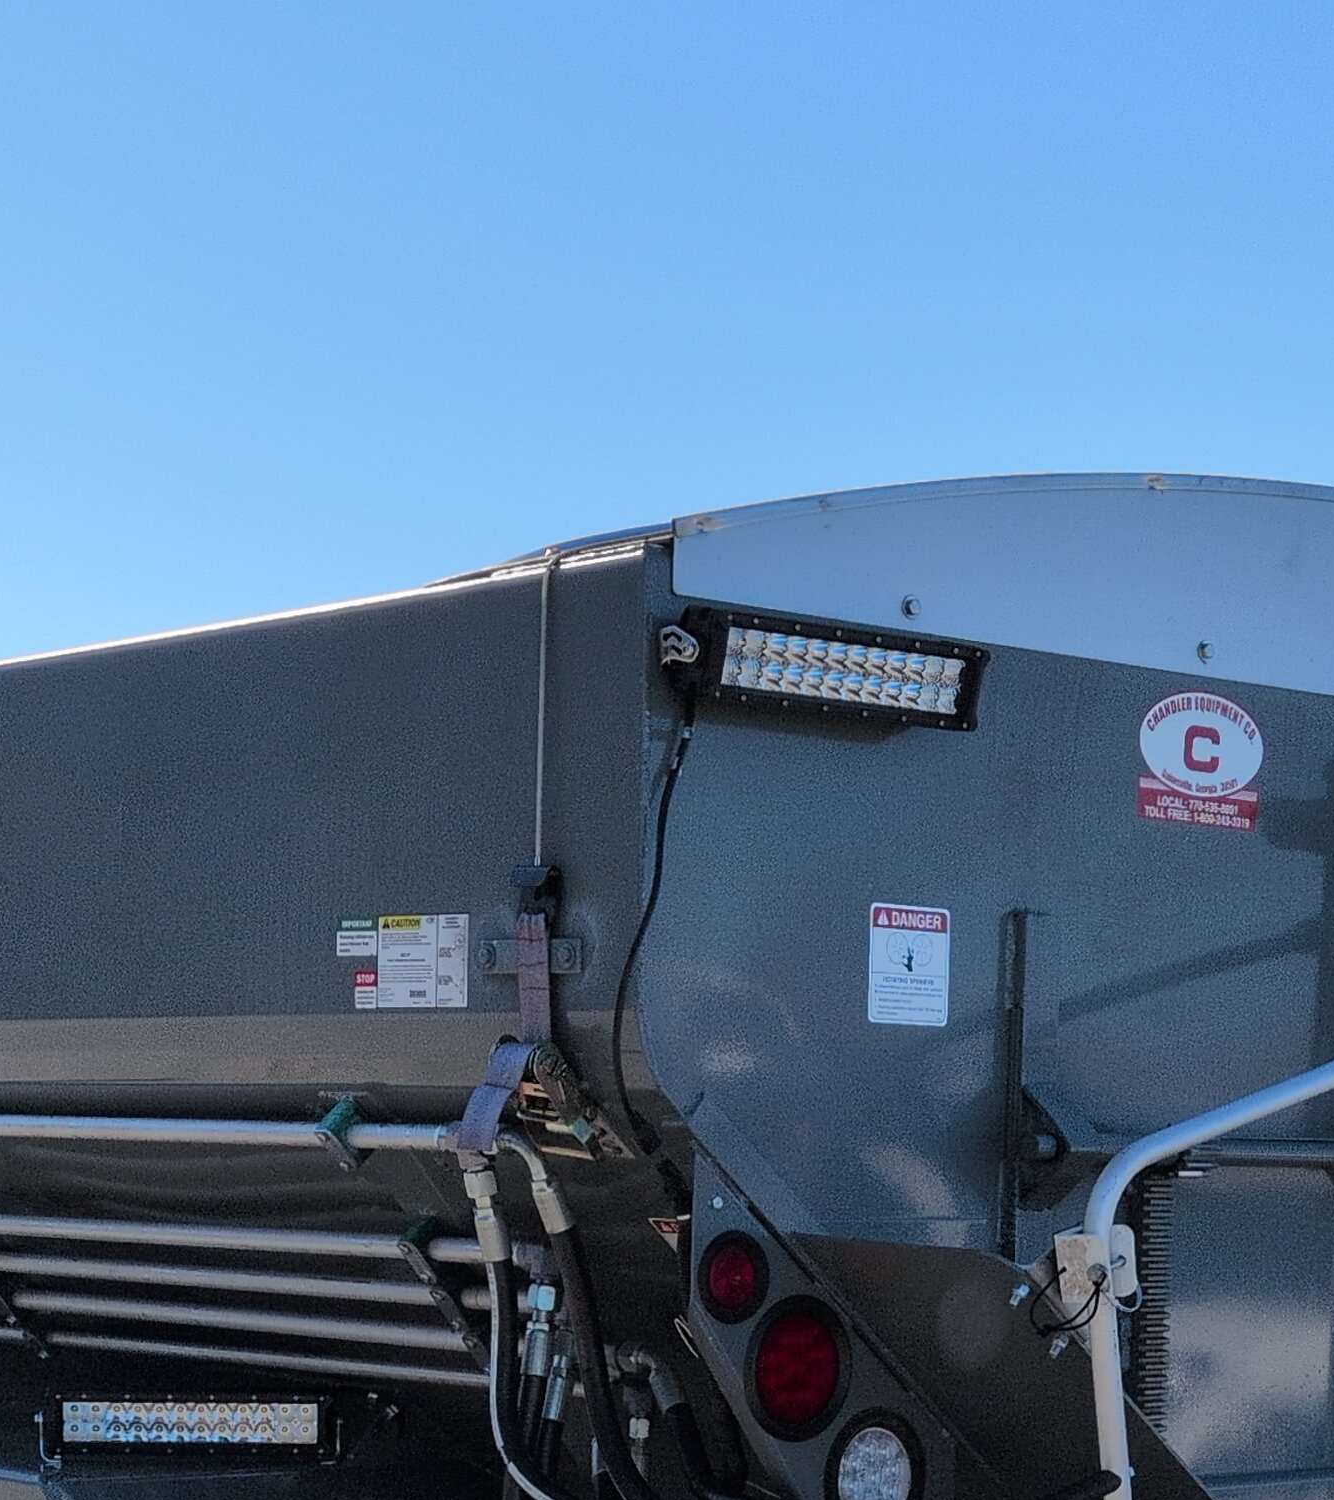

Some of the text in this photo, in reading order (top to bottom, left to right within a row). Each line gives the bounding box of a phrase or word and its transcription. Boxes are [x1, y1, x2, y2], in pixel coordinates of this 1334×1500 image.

[1146, 696, 1193, 731] CHANDLER
[1195, 695, 1245, 727] EQUIPMENT
[1183, 725, 1220, 773] C
[1144, 805, 1166, 818] TOLL
[390, 918, 421, 928] CAUTION
[891, 911, 942, 930] DANGER
[356, 973, 375, 985] STOP
